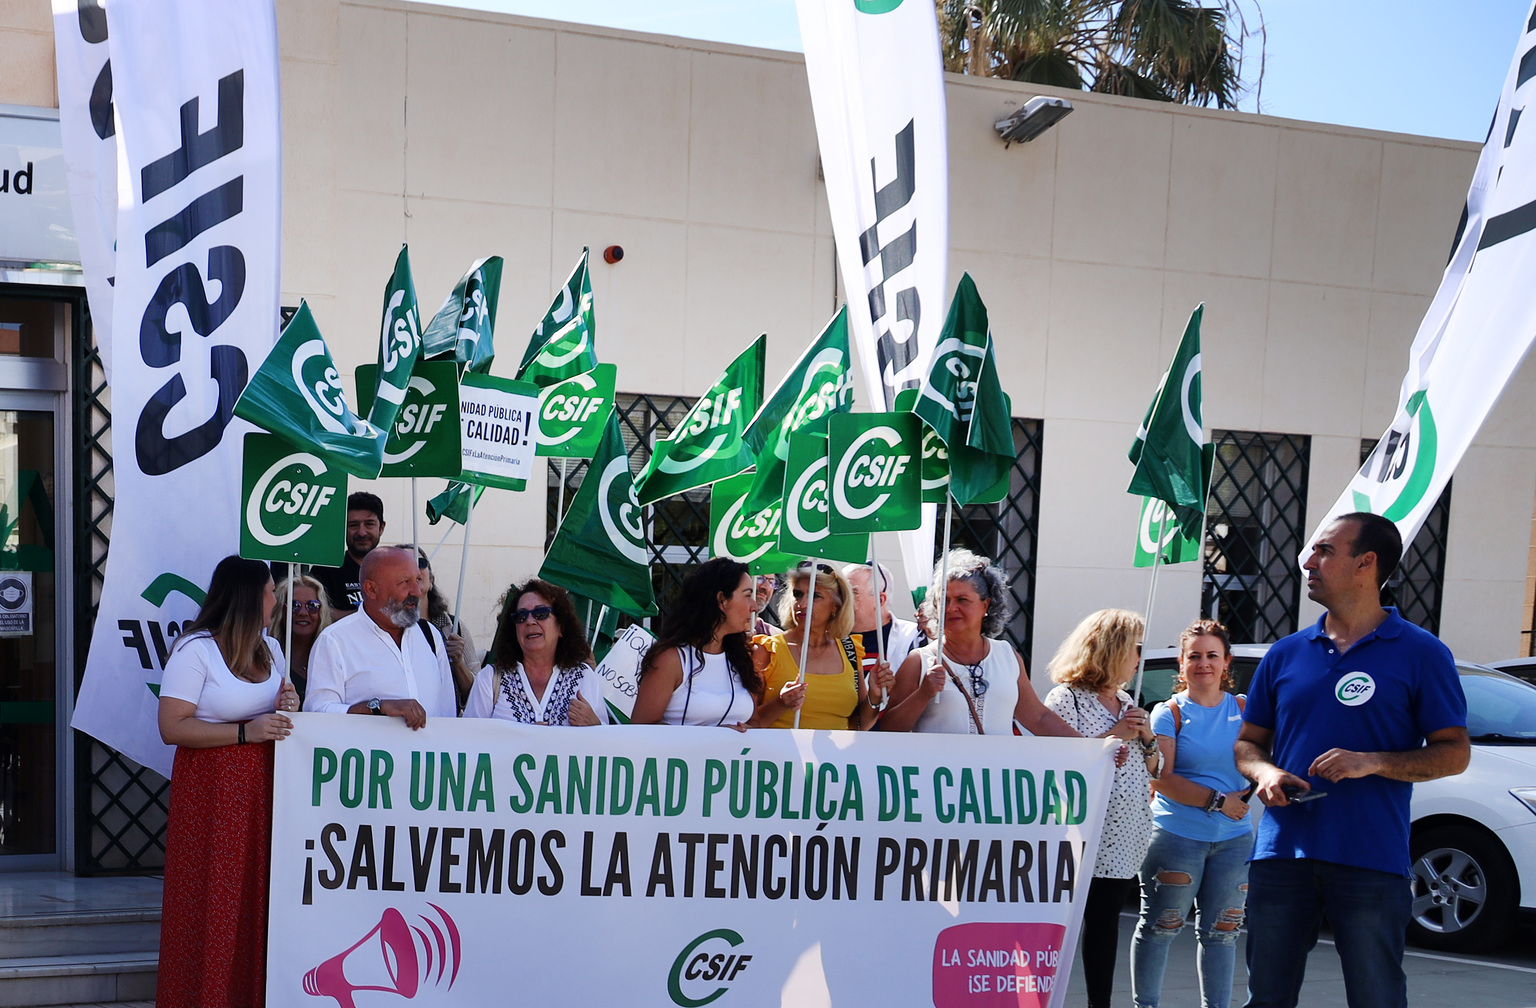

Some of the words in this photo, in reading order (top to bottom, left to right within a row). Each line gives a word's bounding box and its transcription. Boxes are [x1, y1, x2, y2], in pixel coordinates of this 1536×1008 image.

[396, 404, 447, 435] SIF
[460, 401, 486, 416] NIDAD
[489, 404, 522, 422] PÚBLICA
[543, 394, 604, 422] CSIF
[467, 420, 519, 446] CALIDAD
[847, 455, 911, 488] CSIF
[265, 480, 336, 517] CSIF
[597, 664, 616, 681] NO
[1344, 683, 1371, 693] CSIF
[312, 747, 394, 809] POR
[409, 751, 495, 812] UNA
[509, 753, 689, 817] SANIDAD
[702, 747, 863, 821] PÚBLICA
[877, 765, 922, 822] DE
[933, 767, 1087, 825] CALIDAD
[302, 822, 566, 905] ¡SALVEMOS
[580, 831, 632, 897] LA
[646, 823, 861, 900] ATENCIÓN
[874, 837, 1085, 903] PRIMARIA
[685, 952, 753, 981] CSIF
[942, 949, 961, 967] LA
[967, 949, 1030, 968] SANIDAD
